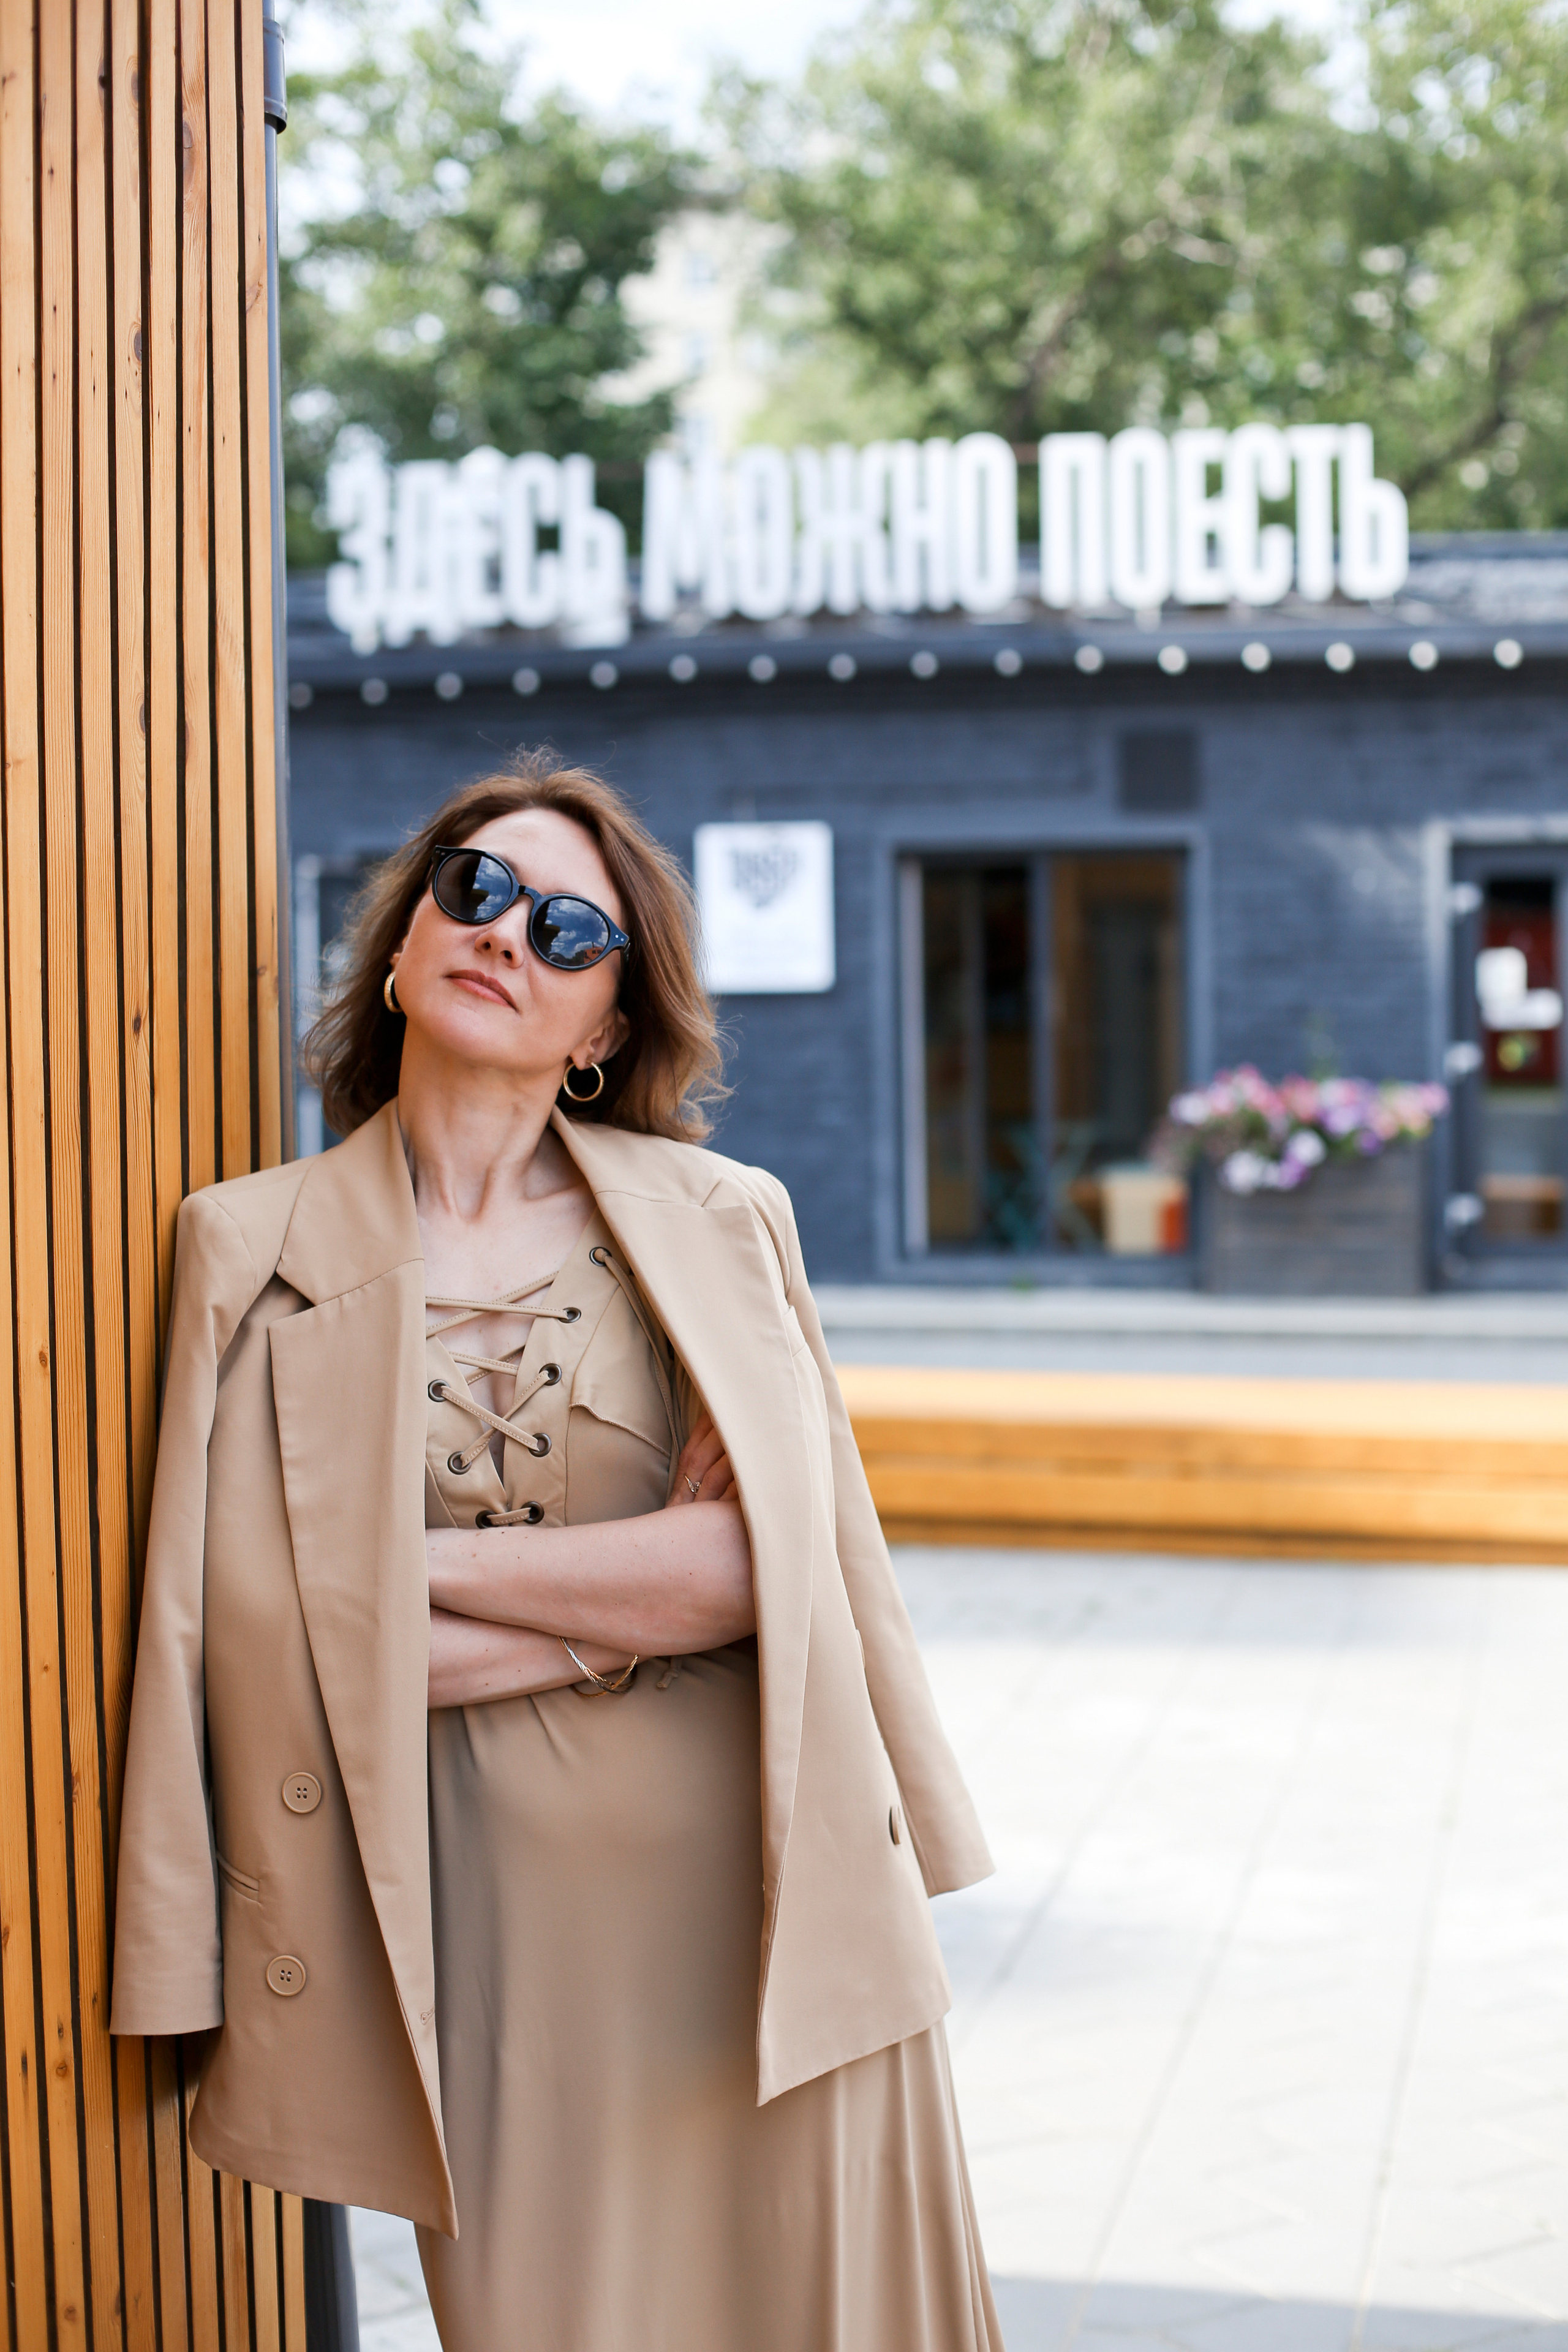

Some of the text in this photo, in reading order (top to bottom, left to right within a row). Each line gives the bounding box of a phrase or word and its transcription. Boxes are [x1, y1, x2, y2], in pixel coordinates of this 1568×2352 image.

[326, 423, 1409, 646] ЗДЕСЬ МОЖНО ПОЕСТЬ
